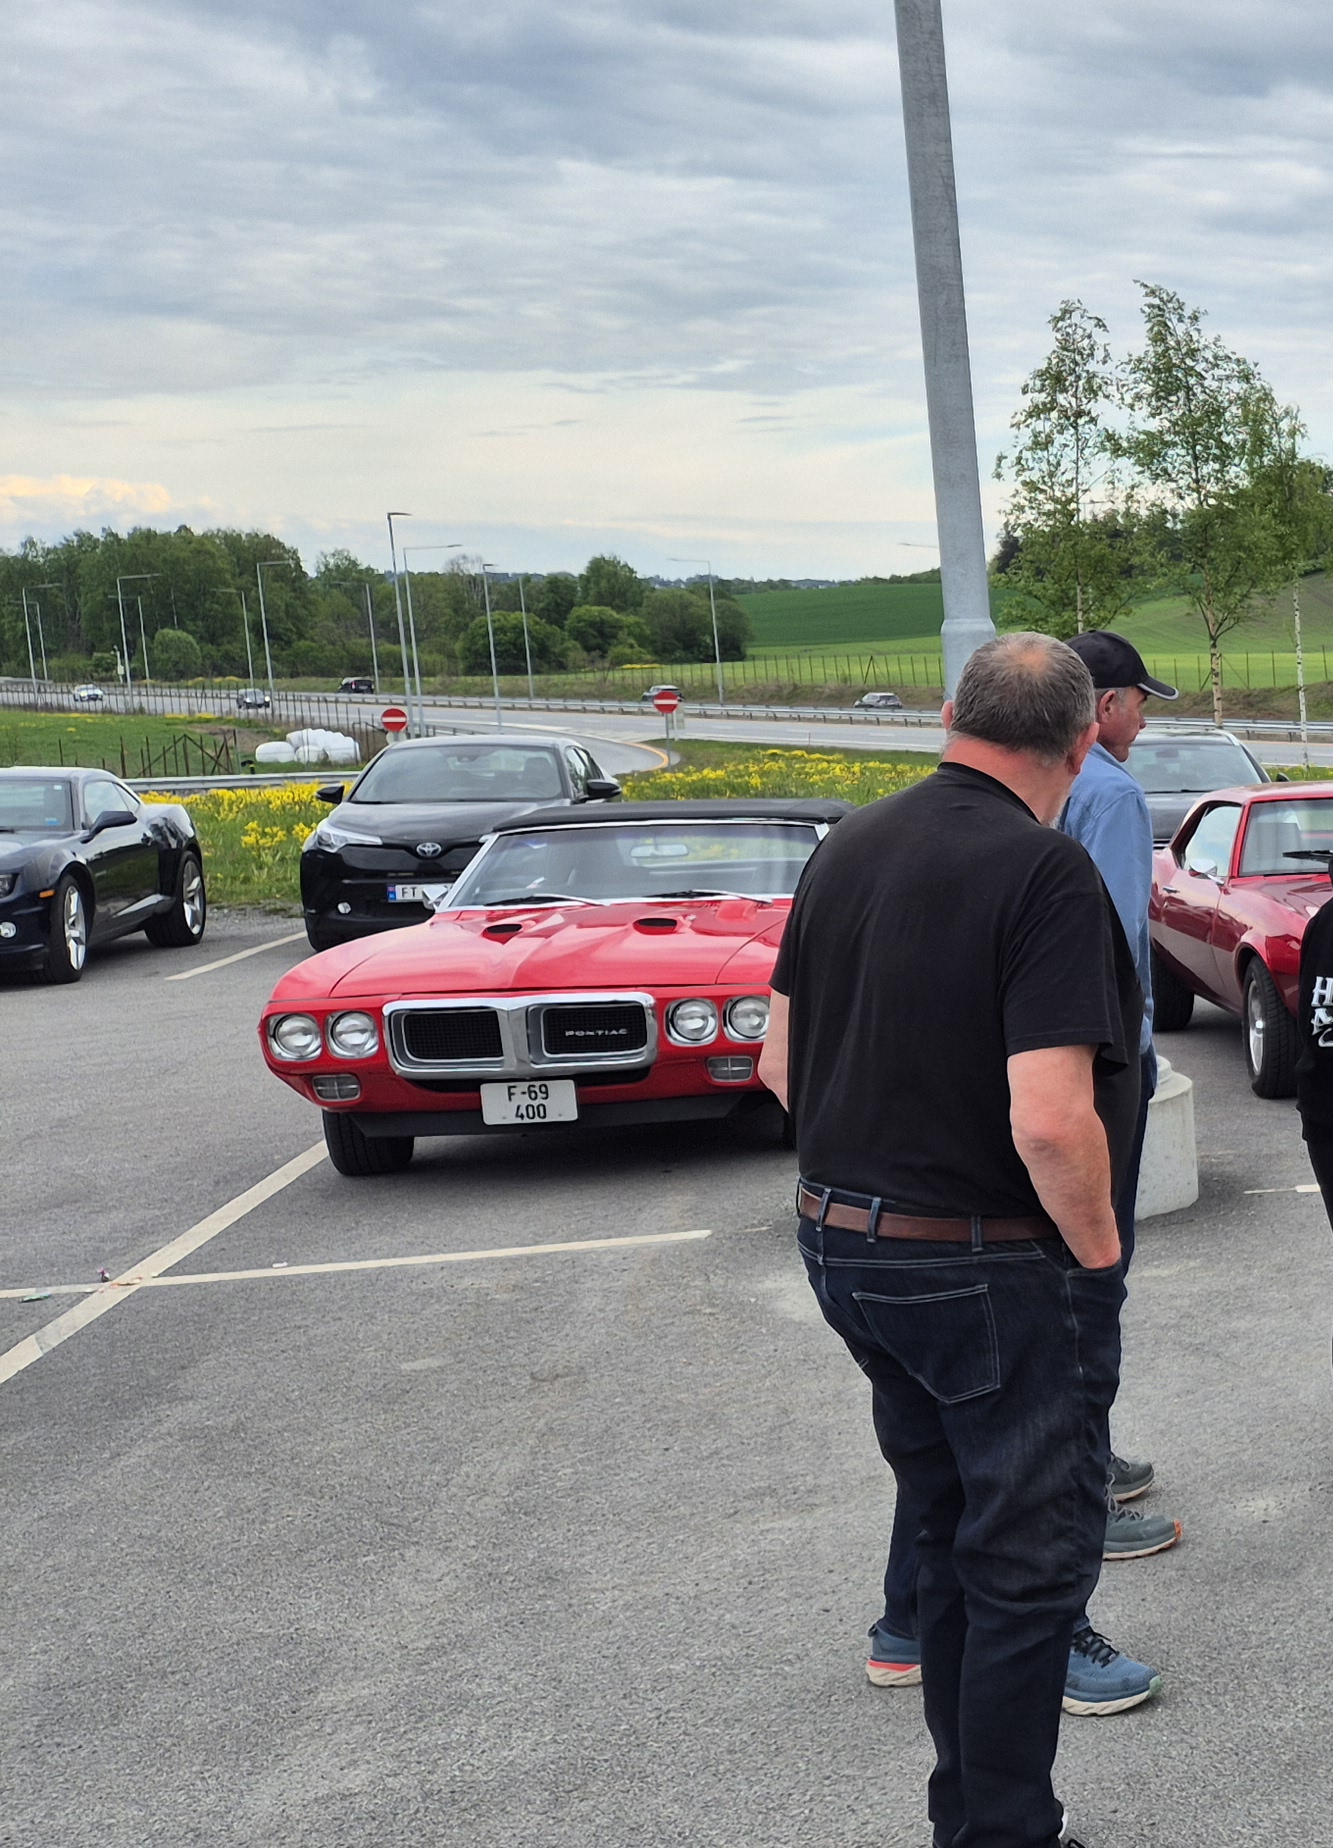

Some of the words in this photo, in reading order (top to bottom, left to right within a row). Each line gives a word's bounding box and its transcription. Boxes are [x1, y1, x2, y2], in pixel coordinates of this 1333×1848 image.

[565, 1028, 628, 1037] PONTIAC
[507, 1083, 549, 1103] F-69
[515, 1103, 547, 1121] 400
